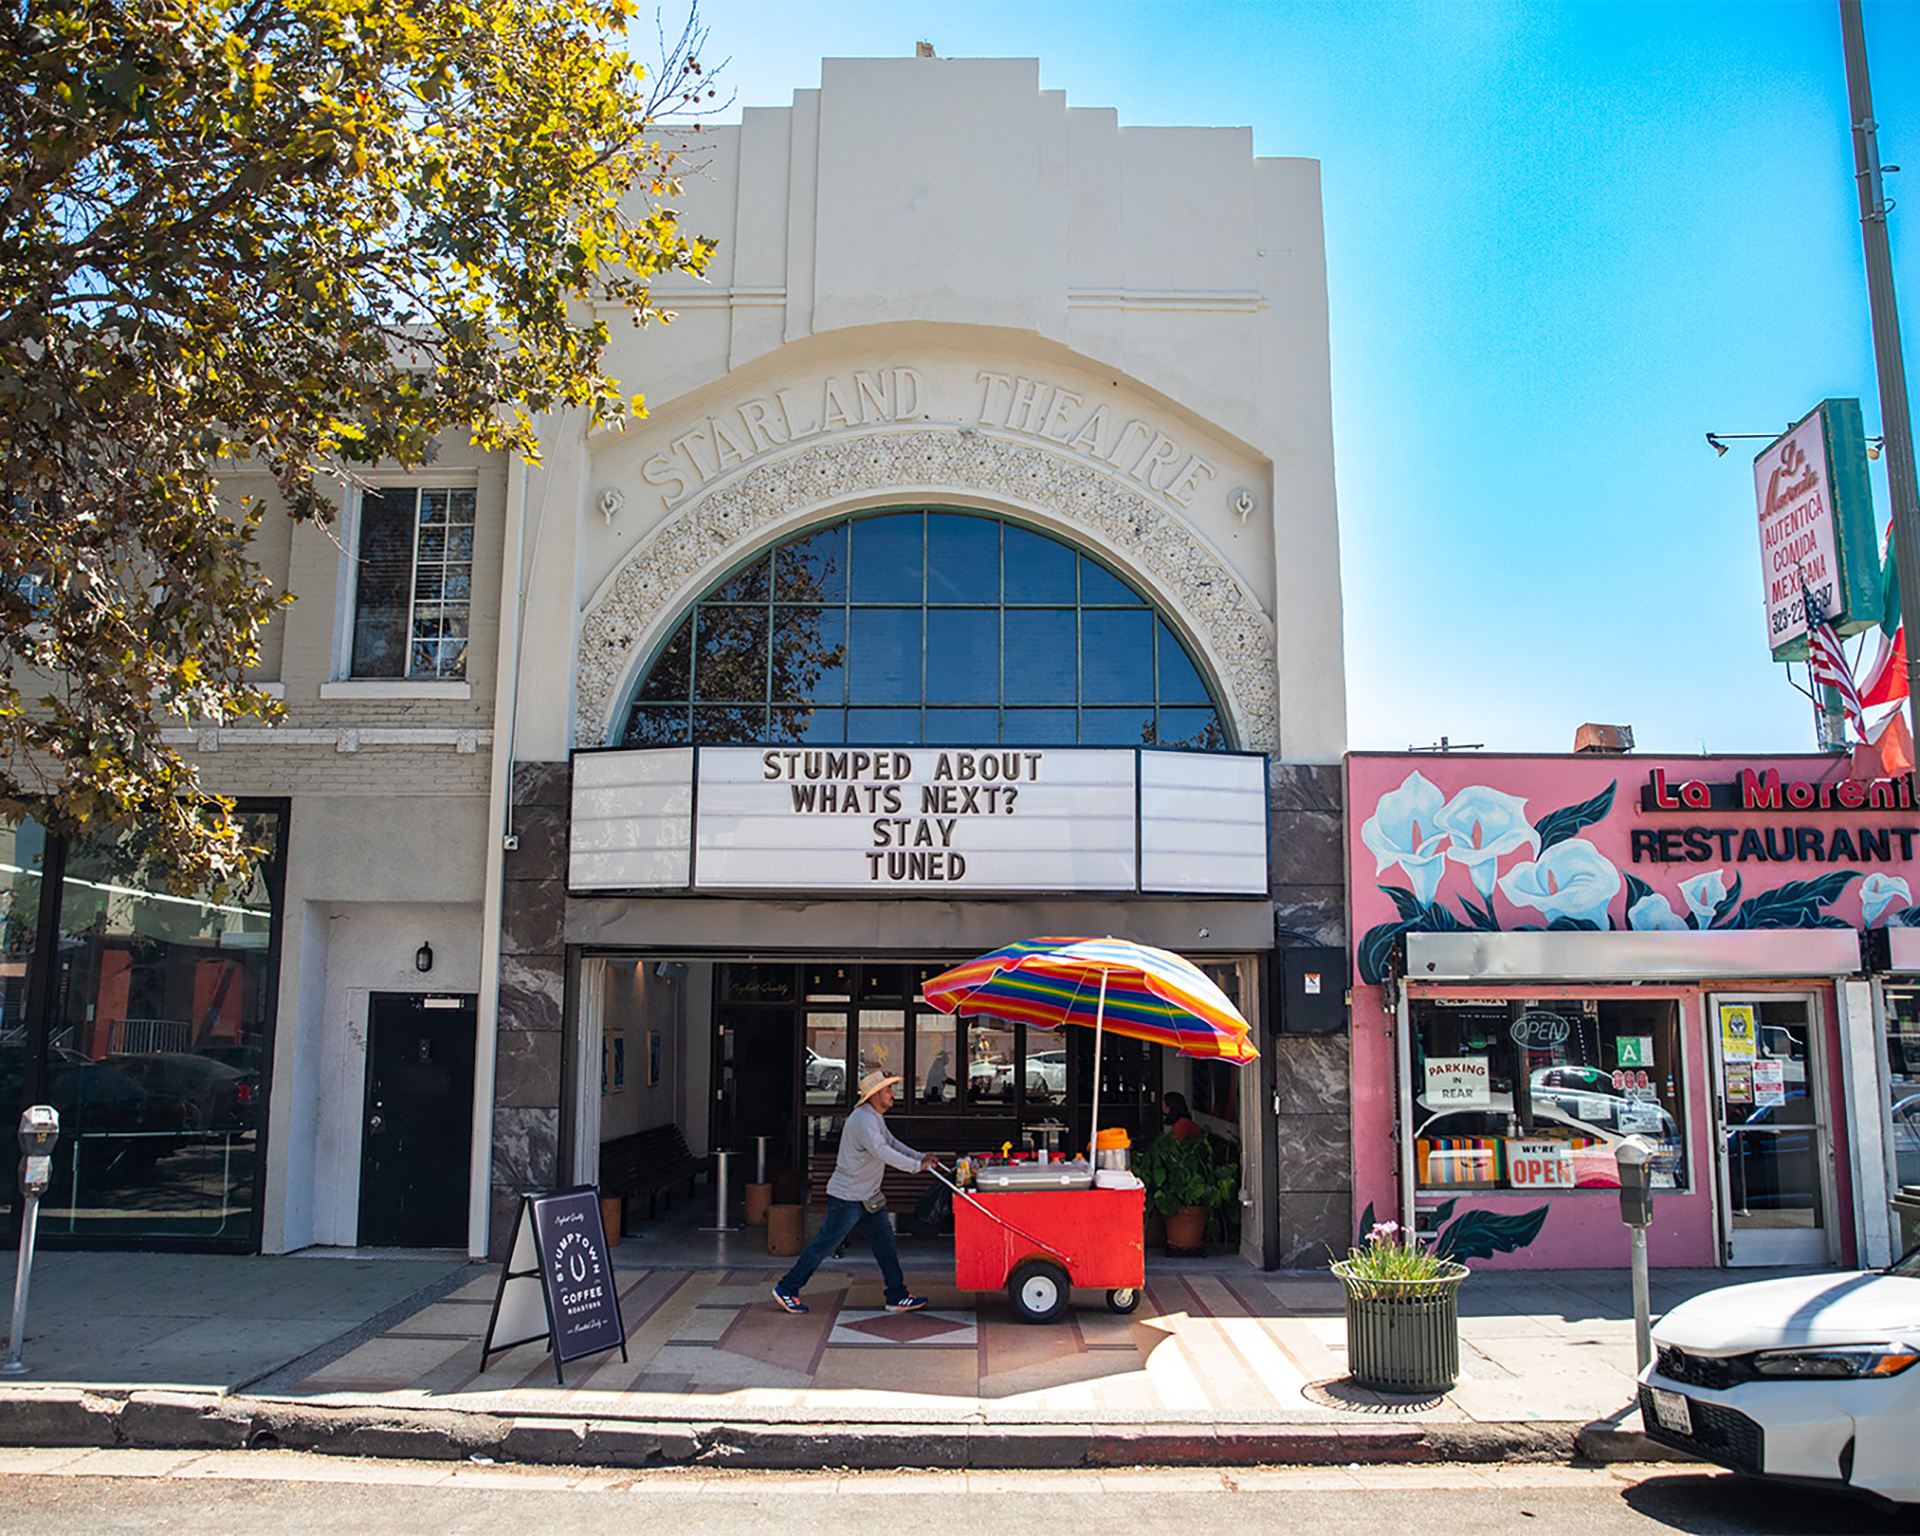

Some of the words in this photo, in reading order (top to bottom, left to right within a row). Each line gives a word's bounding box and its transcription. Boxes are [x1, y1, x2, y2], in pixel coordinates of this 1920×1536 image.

[641, 367, 926, 511] STARLAND
[975, 371, 1217, 509] THEATRE
[1773, 530, 1817, 572] COMIDA
[763, 751, 911, 780] STUMPED
[934, 752, 1042, 781] ABOUT
[791, 784, 902, 813] WHATS
[920, 785, 1018, 814] NEXT?
[1650, 767, 1711, 808] La
[873, 819, 957, 847] STAY
[1631, 827, 1919, 863] RESTAURANT
[866, 852, 966, 880] TUNED
[1514, 1021, 1564, 1041] OPEN
[1623, 1045, 1637, 1061] A
[1428, 1063, 1485, 1076] PARKING
[1442, 1088, 1473, 1099] REAR
[1522, 1145, 1555, 1154] WE'RE
[1514, 1159, 1571, 1184] OPEN
[555, 1232, 600, 1282] STUMPTOWN
[562, 1286, 603, 1306] COFFEE
[567, 1301, 601, 1315] ROASTERS
